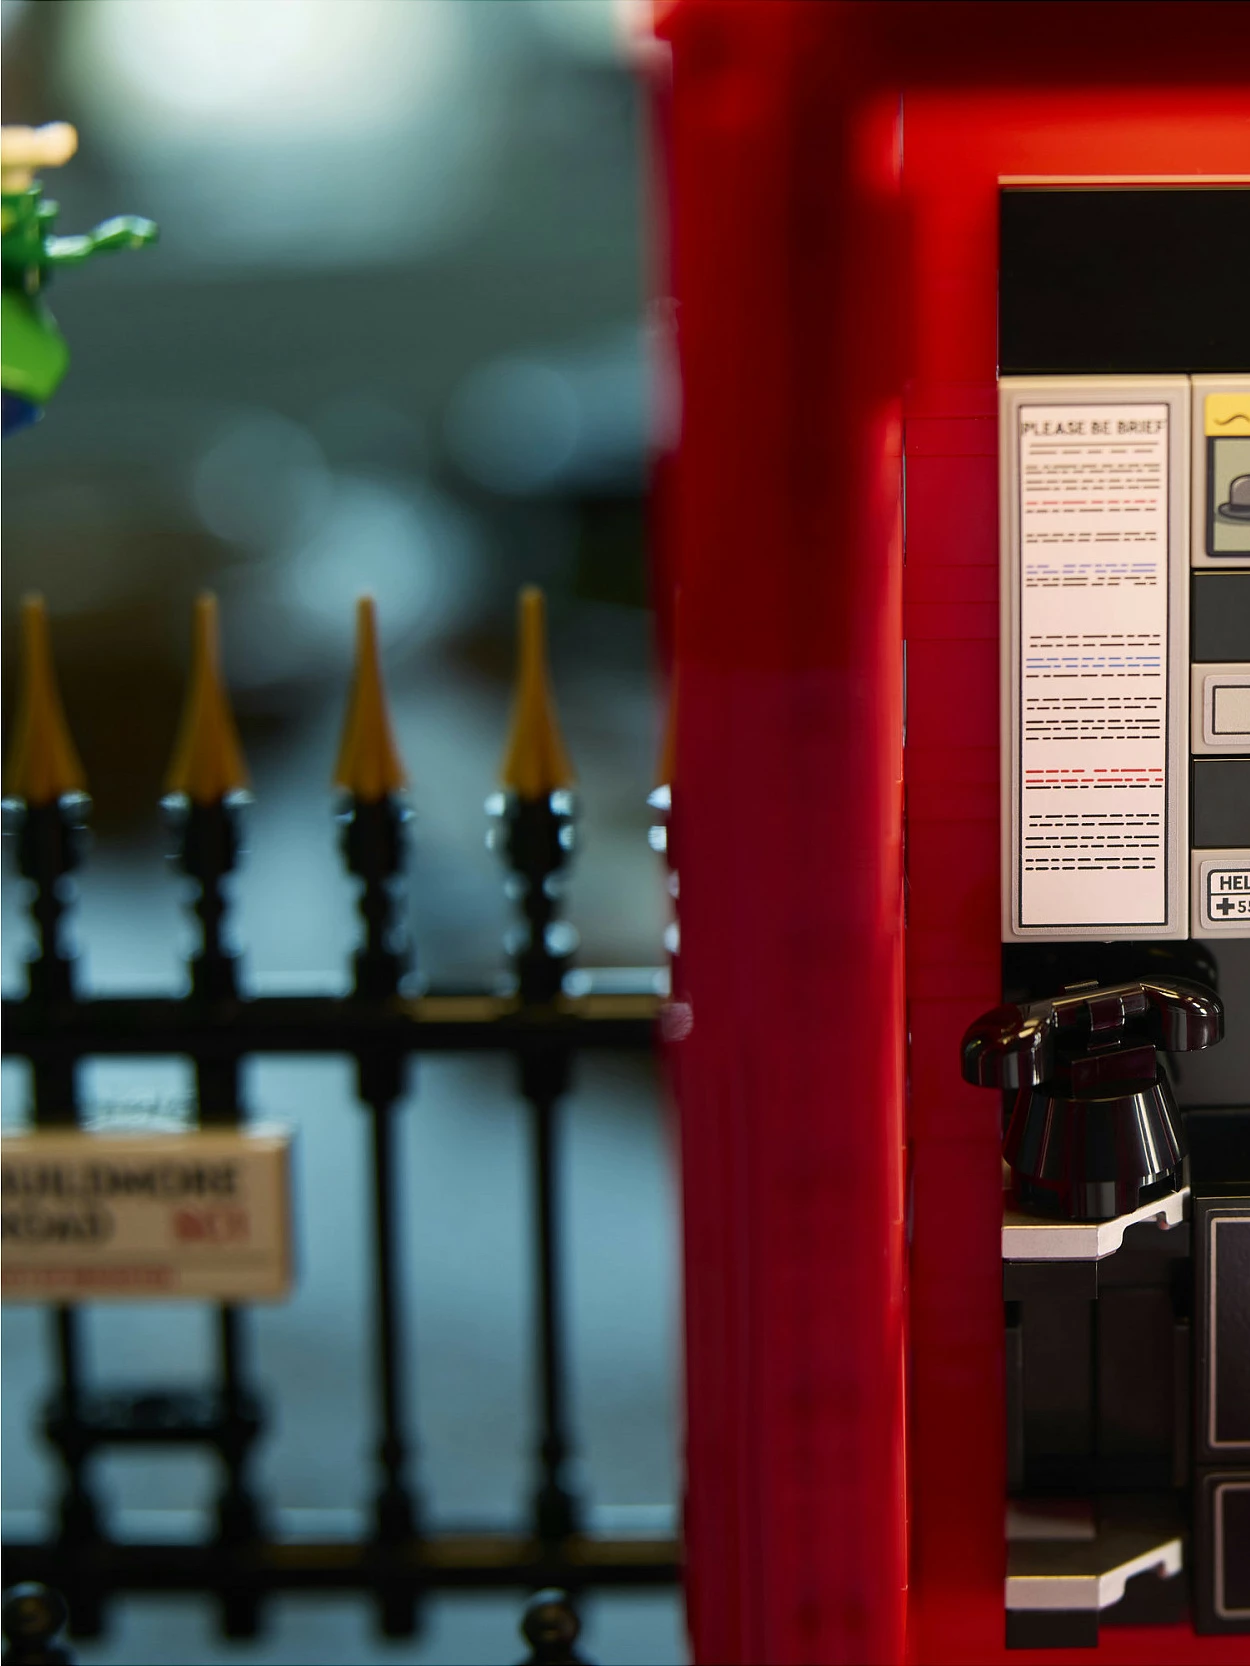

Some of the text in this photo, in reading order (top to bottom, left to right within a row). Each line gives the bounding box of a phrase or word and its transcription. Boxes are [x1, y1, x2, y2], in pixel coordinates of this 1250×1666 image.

[1020, 418, 1166, 437] PLEASE BE BRIEF
